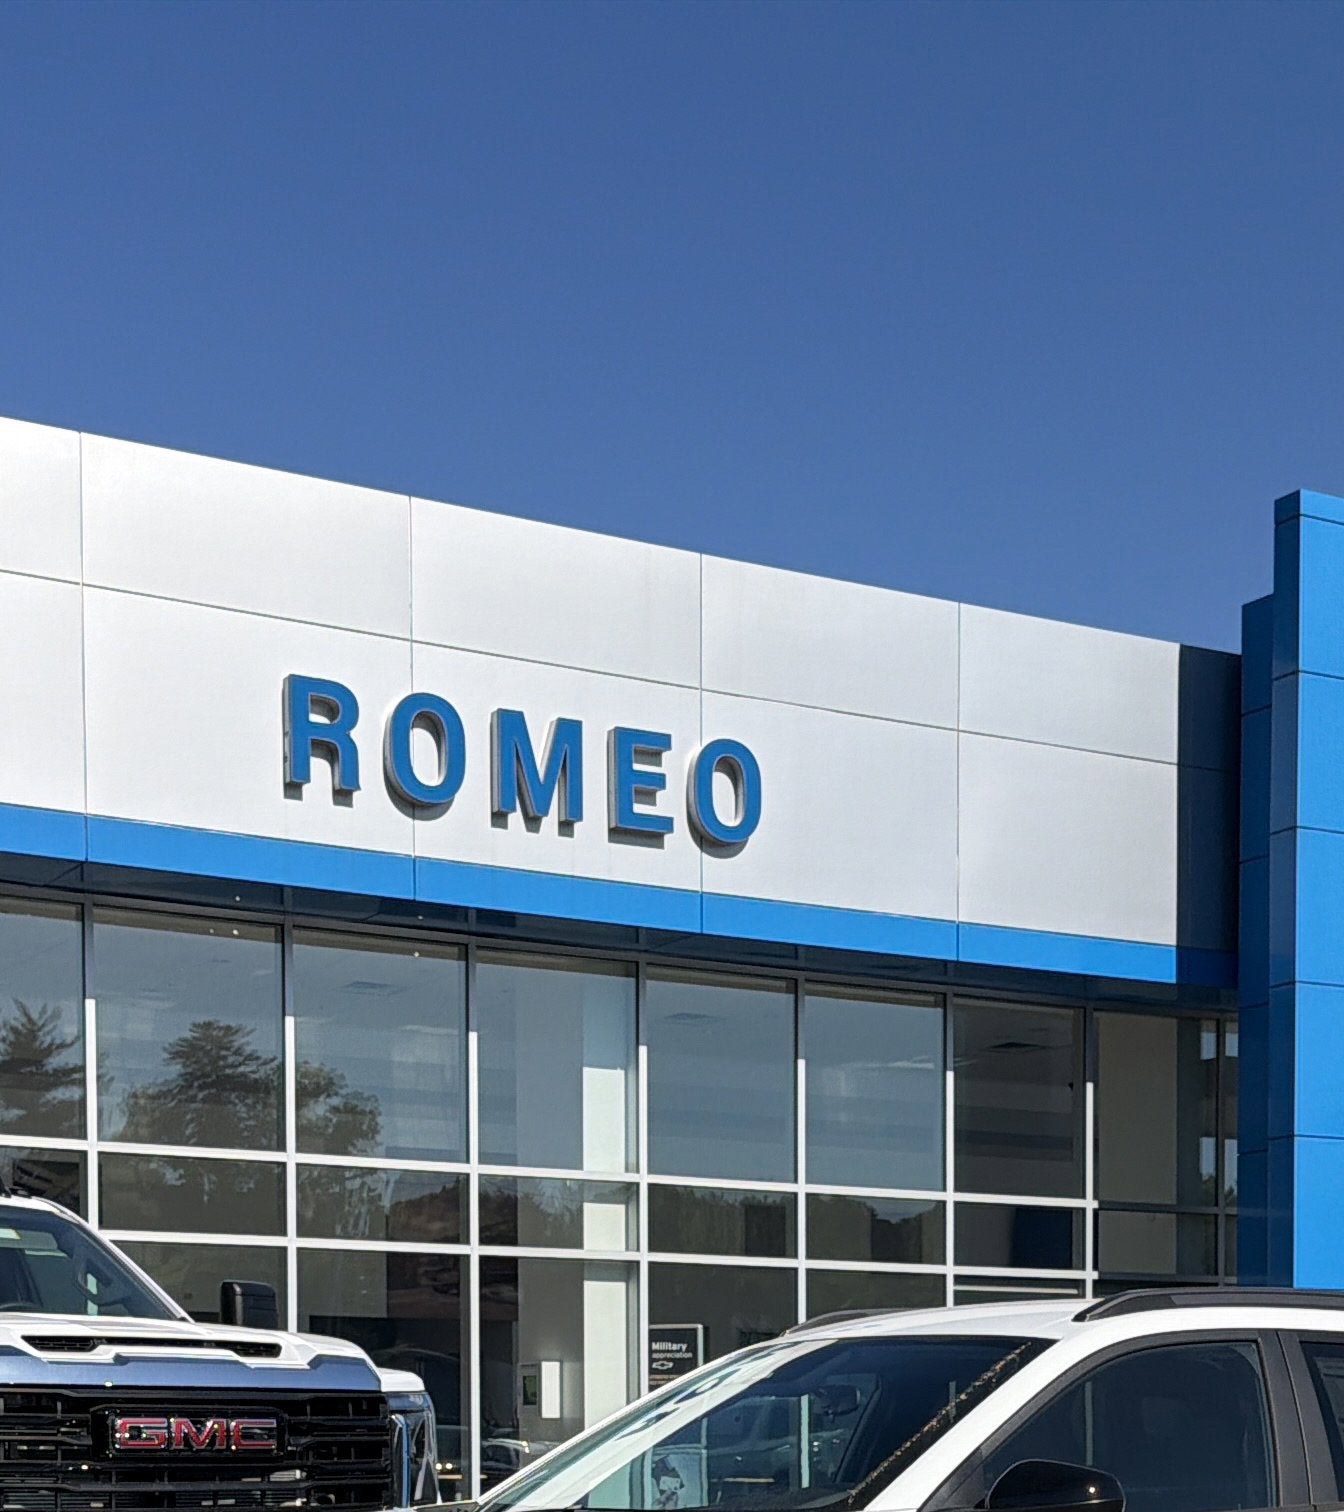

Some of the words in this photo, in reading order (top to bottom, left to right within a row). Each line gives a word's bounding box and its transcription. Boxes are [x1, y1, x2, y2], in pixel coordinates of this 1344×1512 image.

[283, 674, 761, 843] ROMEO
[652, 1342, 688, 1352] Military
[115, 1417, 277, 1450] GMC
